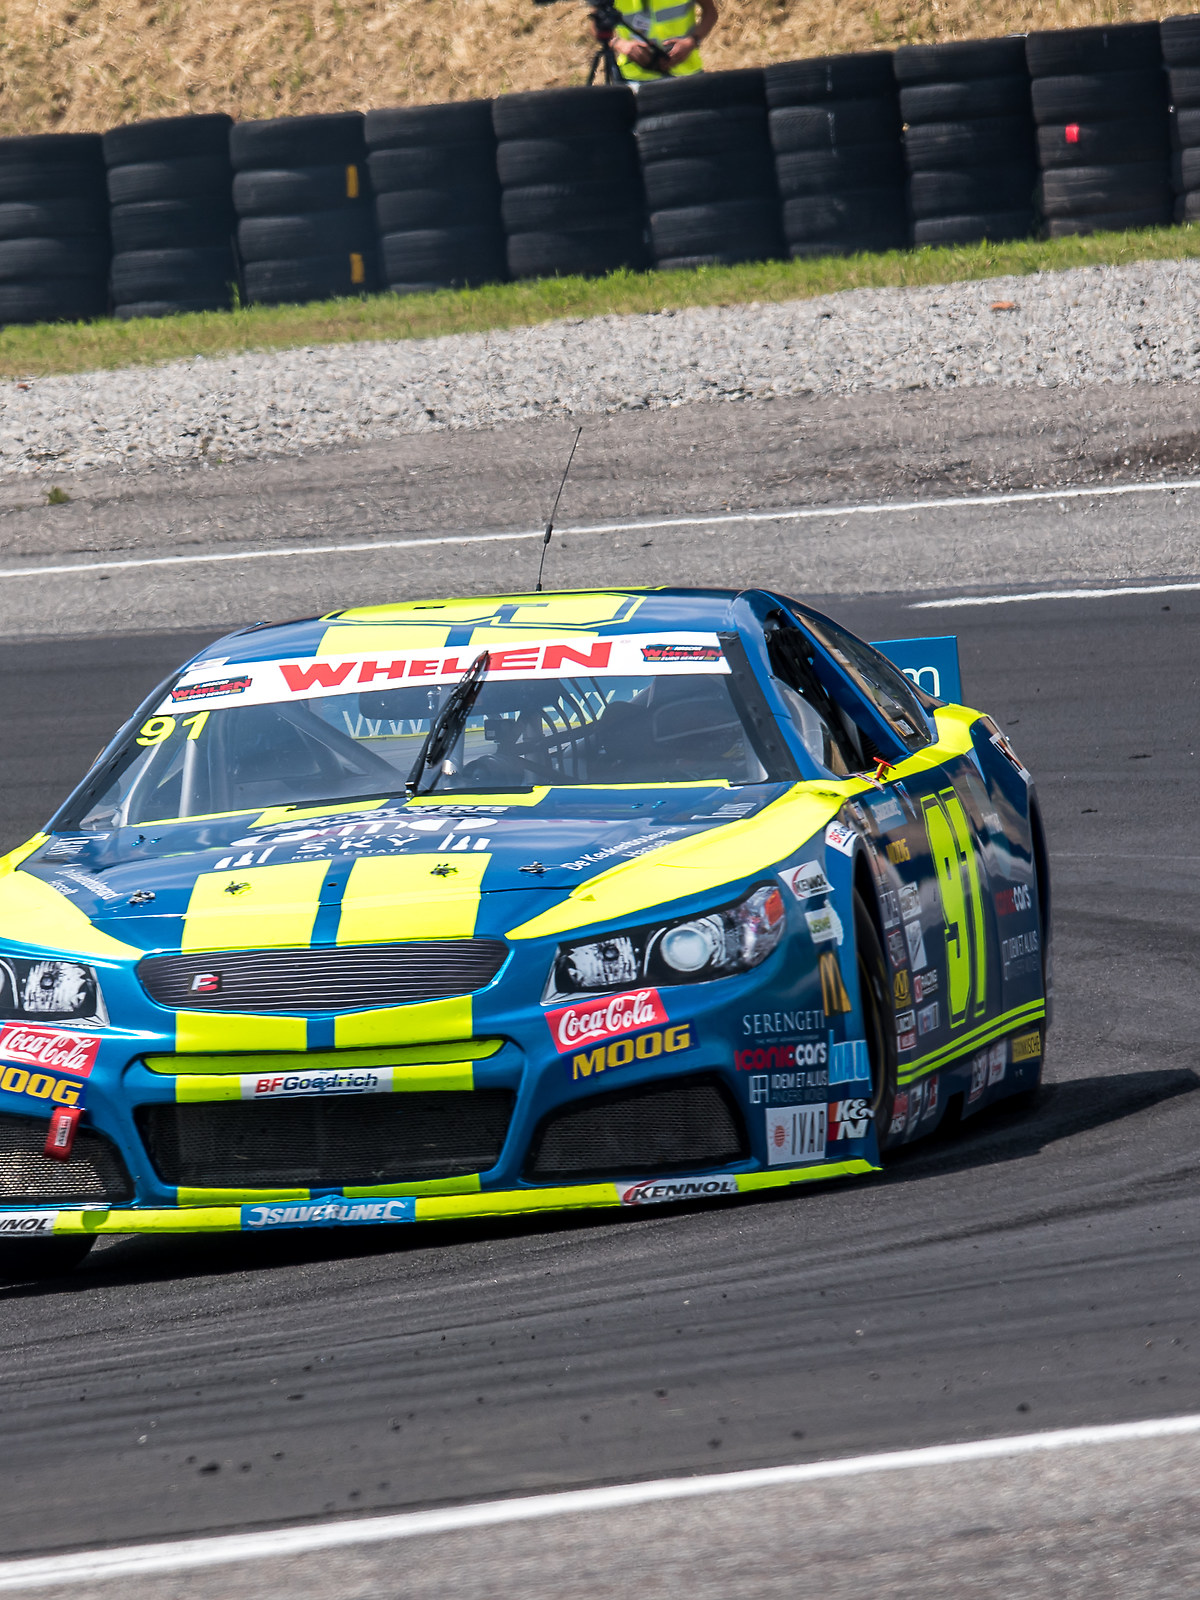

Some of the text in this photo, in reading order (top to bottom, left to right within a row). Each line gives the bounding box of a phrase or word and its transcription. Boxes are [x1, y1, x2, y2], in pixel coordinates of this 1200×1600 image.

[280, 642, 612, 691] WHELEN
[136, 711, 210, 746] 91
[296, 837, 421, 854] SKY
[343, 848, 410, 856] ESTATE
[921, 788, 986, 1028] 91
[558, 991, 655, 1045] Coca-Cola
[743, 1010, 825, 1035] SERENGETI
[0, 1027, 96, 1070] Coca-Cola
[573, 1024, 690, 1080] MOOG
[255, 1073, 378, 1093] BFGoodrich
[631, 1182, 731, 1201] KENNOL
